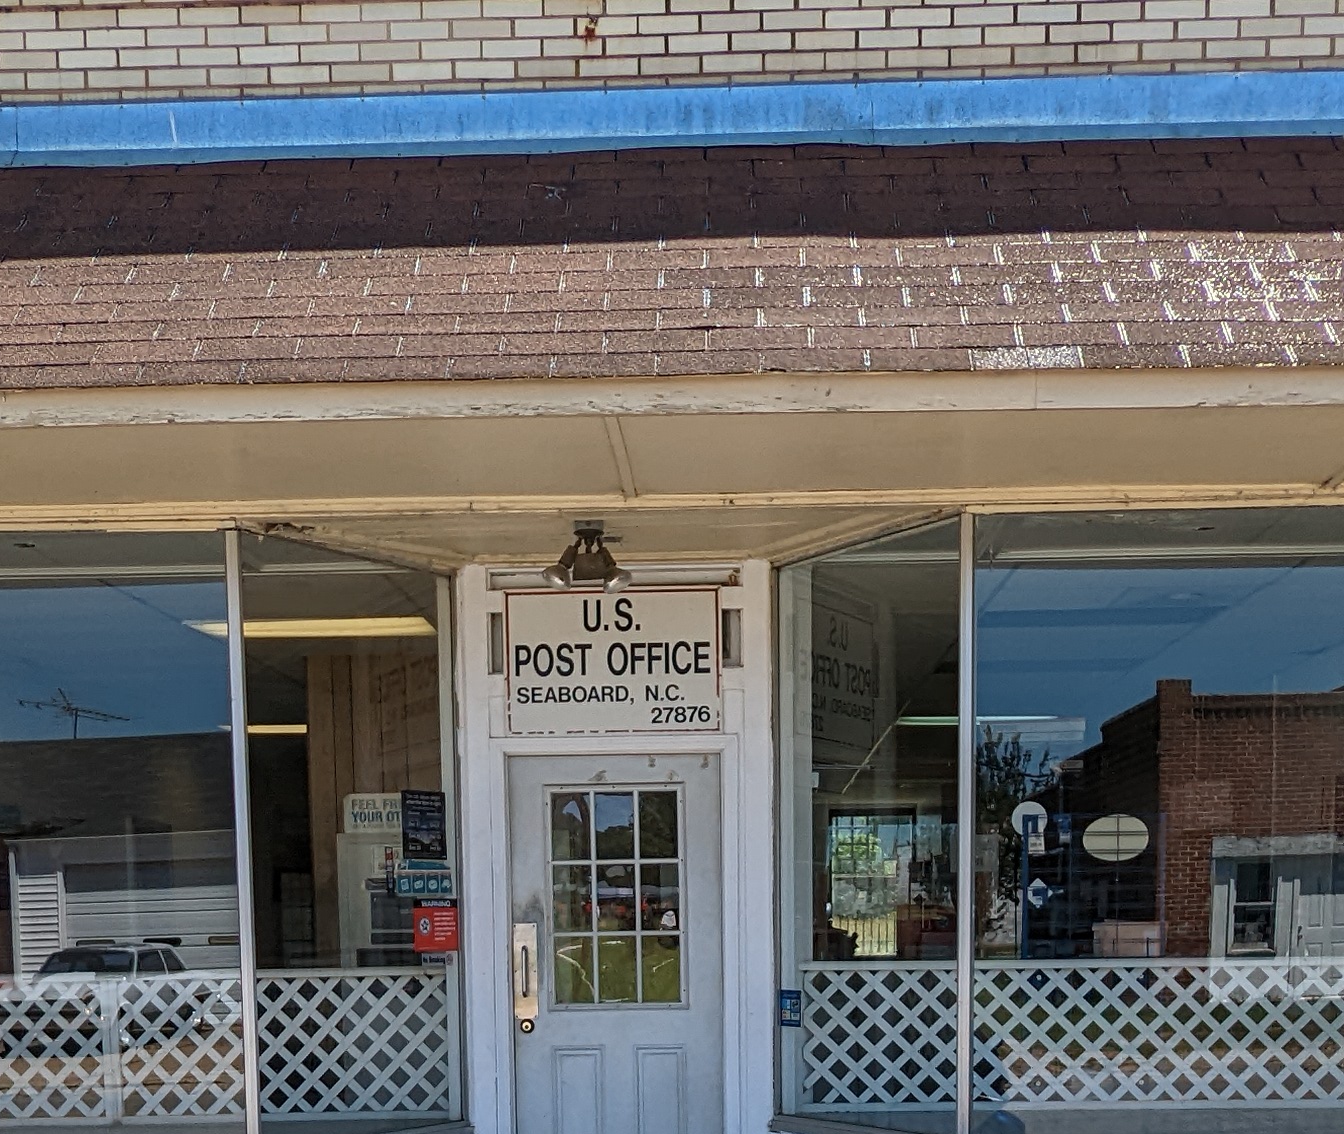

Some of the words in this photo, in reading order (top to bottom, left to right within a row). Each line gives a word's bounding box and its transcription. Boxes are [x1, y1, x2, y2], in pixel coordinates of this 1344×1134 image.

[582, 597, 642, 632] U.S.
[514, 643, 593, 677] POST
[607, 641, 711, 675] OFFICE
[516, 684, 635, 705] SEABOARD,
[645, 683, 685, 702] N.C.
[650, 705, 711, 724] 27876
[351, 799, 378, 810] FEEL
[383, 799, 401, 810] FR
[351, 810, 384, 823] YOUR
[386, 810, 402, 823] OT
